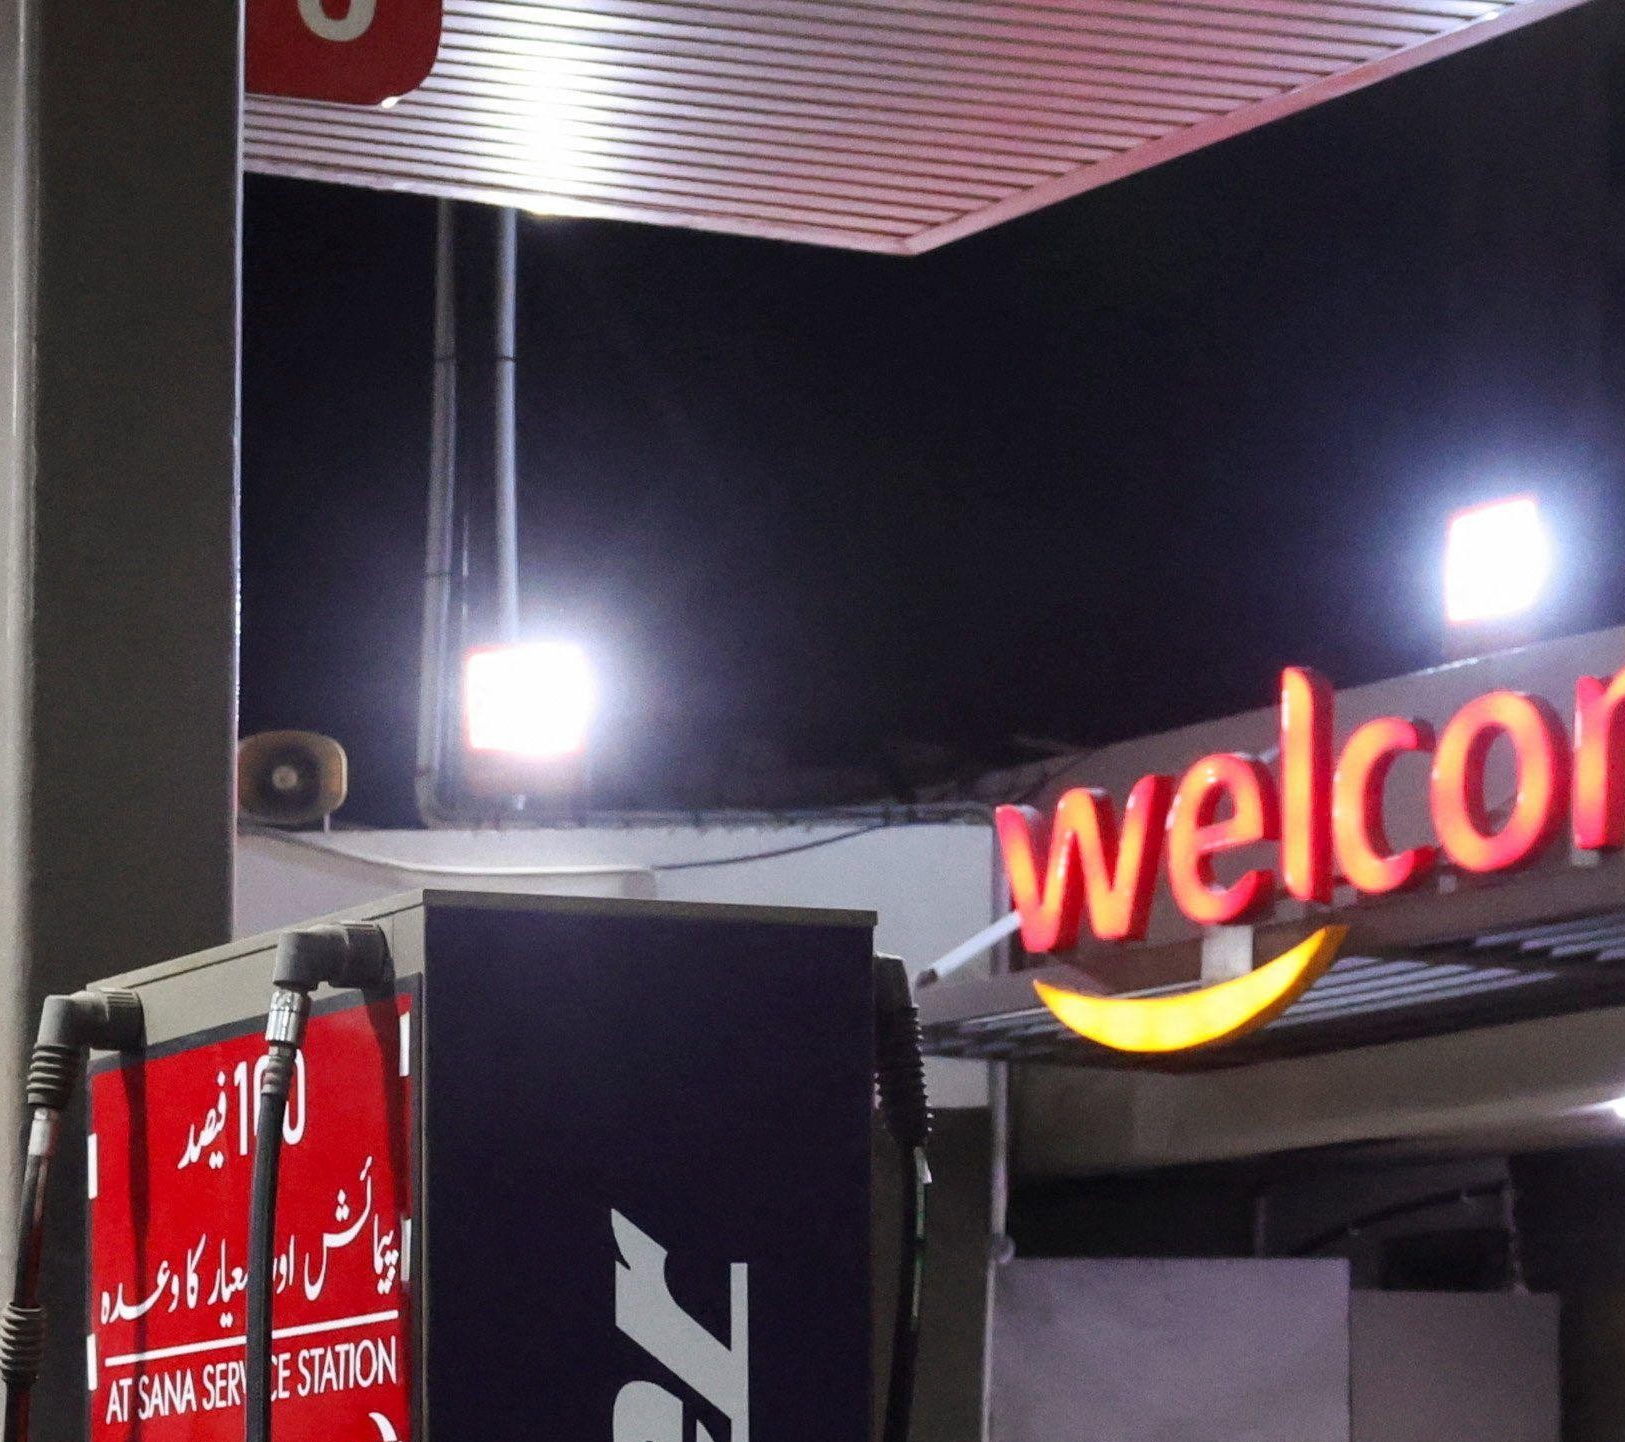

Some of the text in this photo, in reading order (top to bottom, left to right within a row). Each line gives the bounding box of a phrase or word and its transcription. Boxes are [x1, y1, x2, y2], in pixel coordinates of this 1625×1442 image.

[206, 1237, 248, 1328] عیار
[105, 1335, 397, 1425] AT SANA SERVCE STATION
